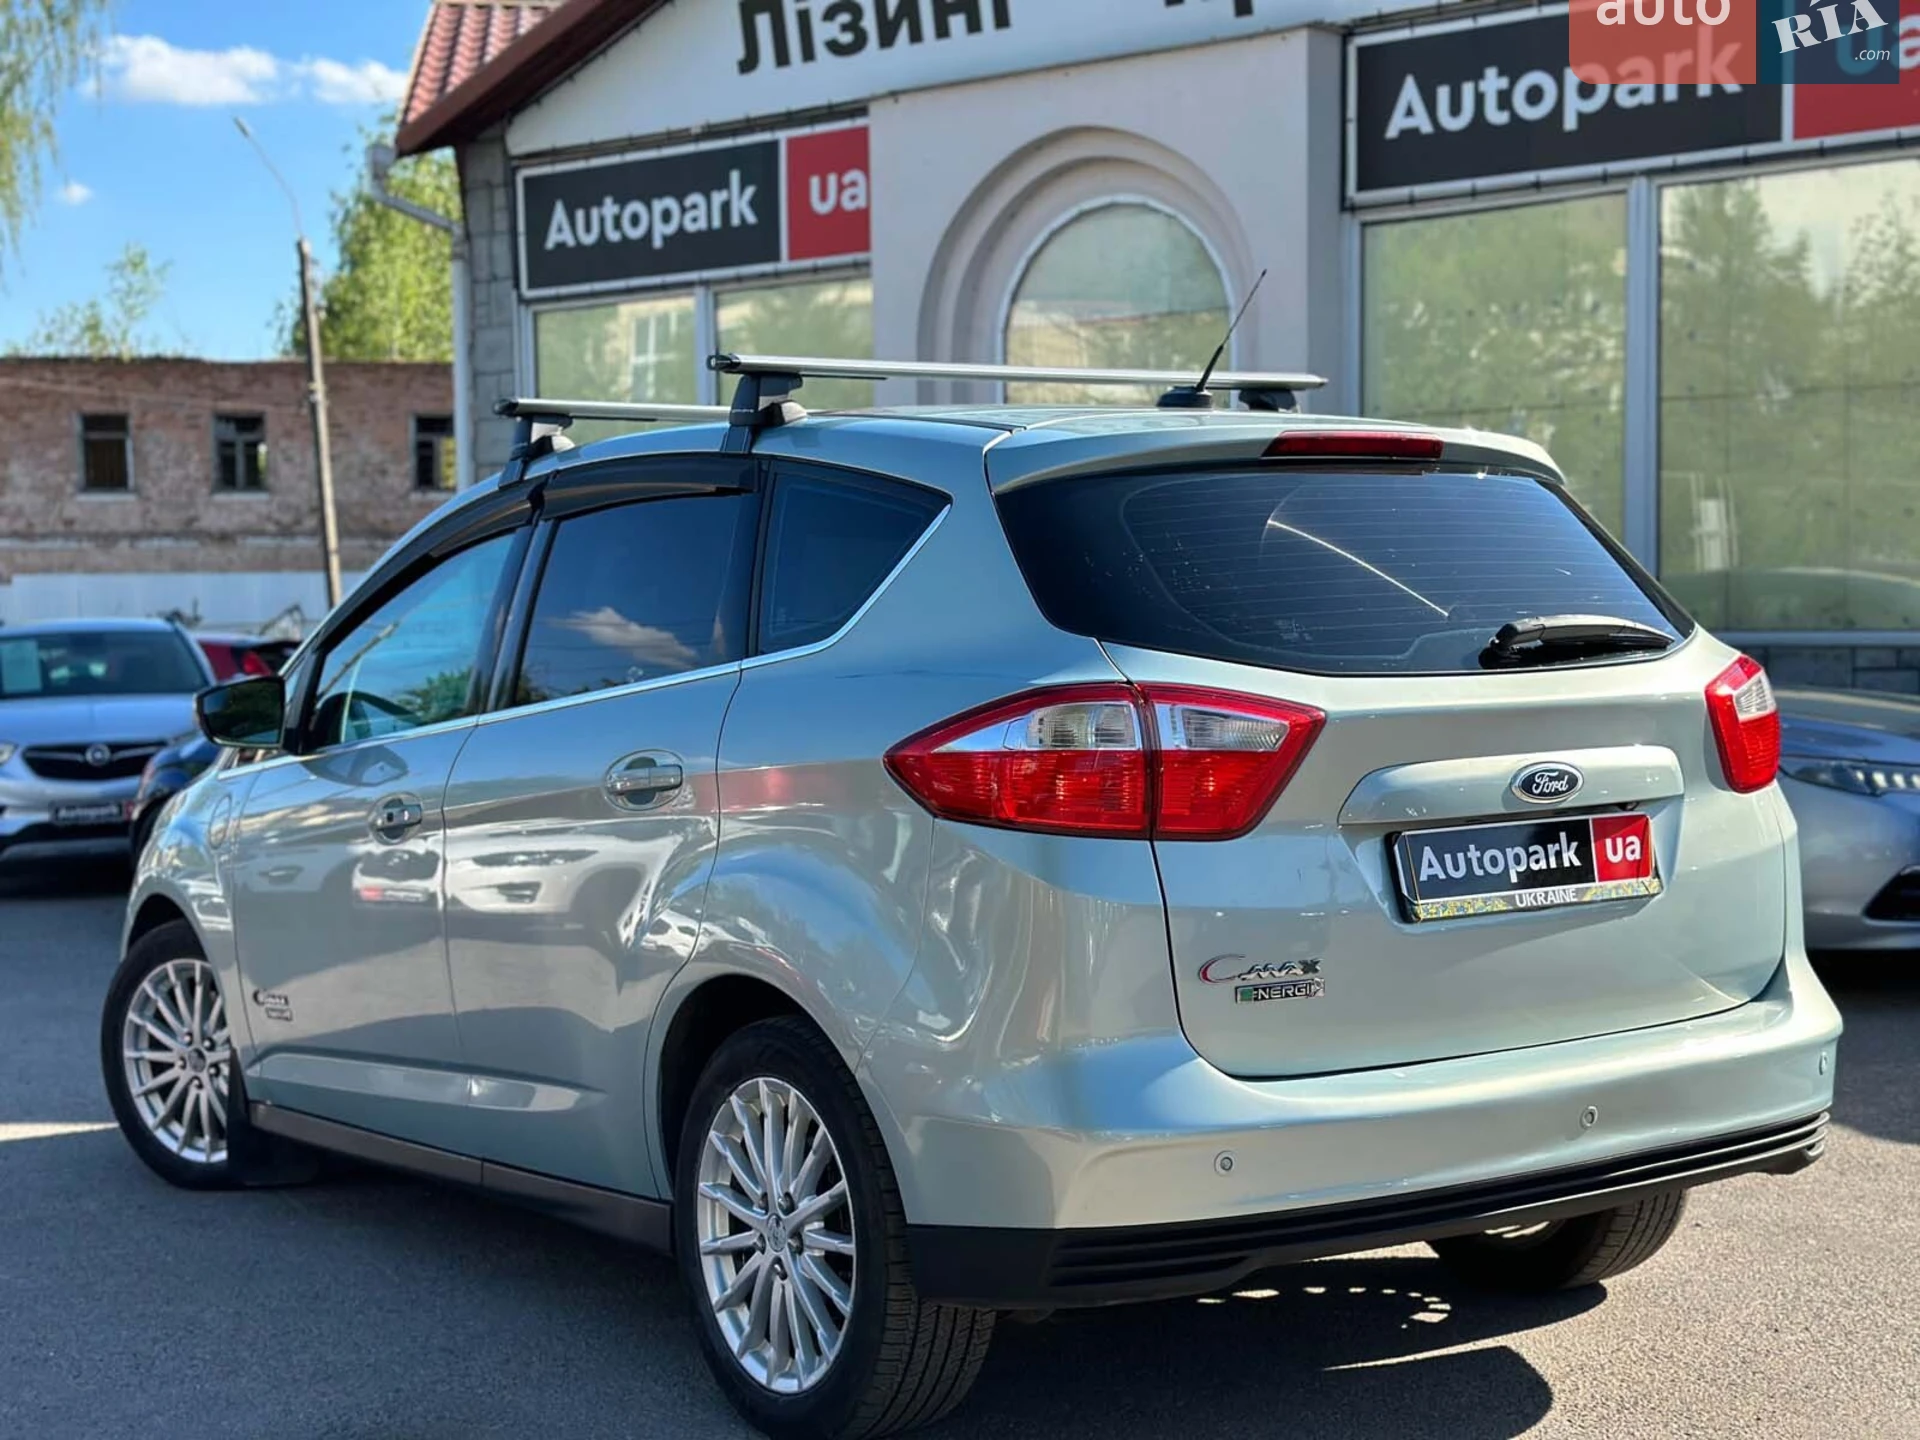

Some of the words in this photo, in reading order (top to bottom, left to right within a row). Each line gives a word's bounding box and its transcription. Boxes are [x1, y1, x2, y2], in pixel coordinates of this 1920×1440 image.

[1384, 23, 1743, 139] Autopark
[545, 169, 758, 250] Autopark
[809, 167, 868, 217] ua
[1532, 771, 1570, 795] Ford
[1418, 831, 1582, 883] Autopark
[1605, 834, 1642, 864] ua
[1515, 887, 1577, 908] UKRAINE
